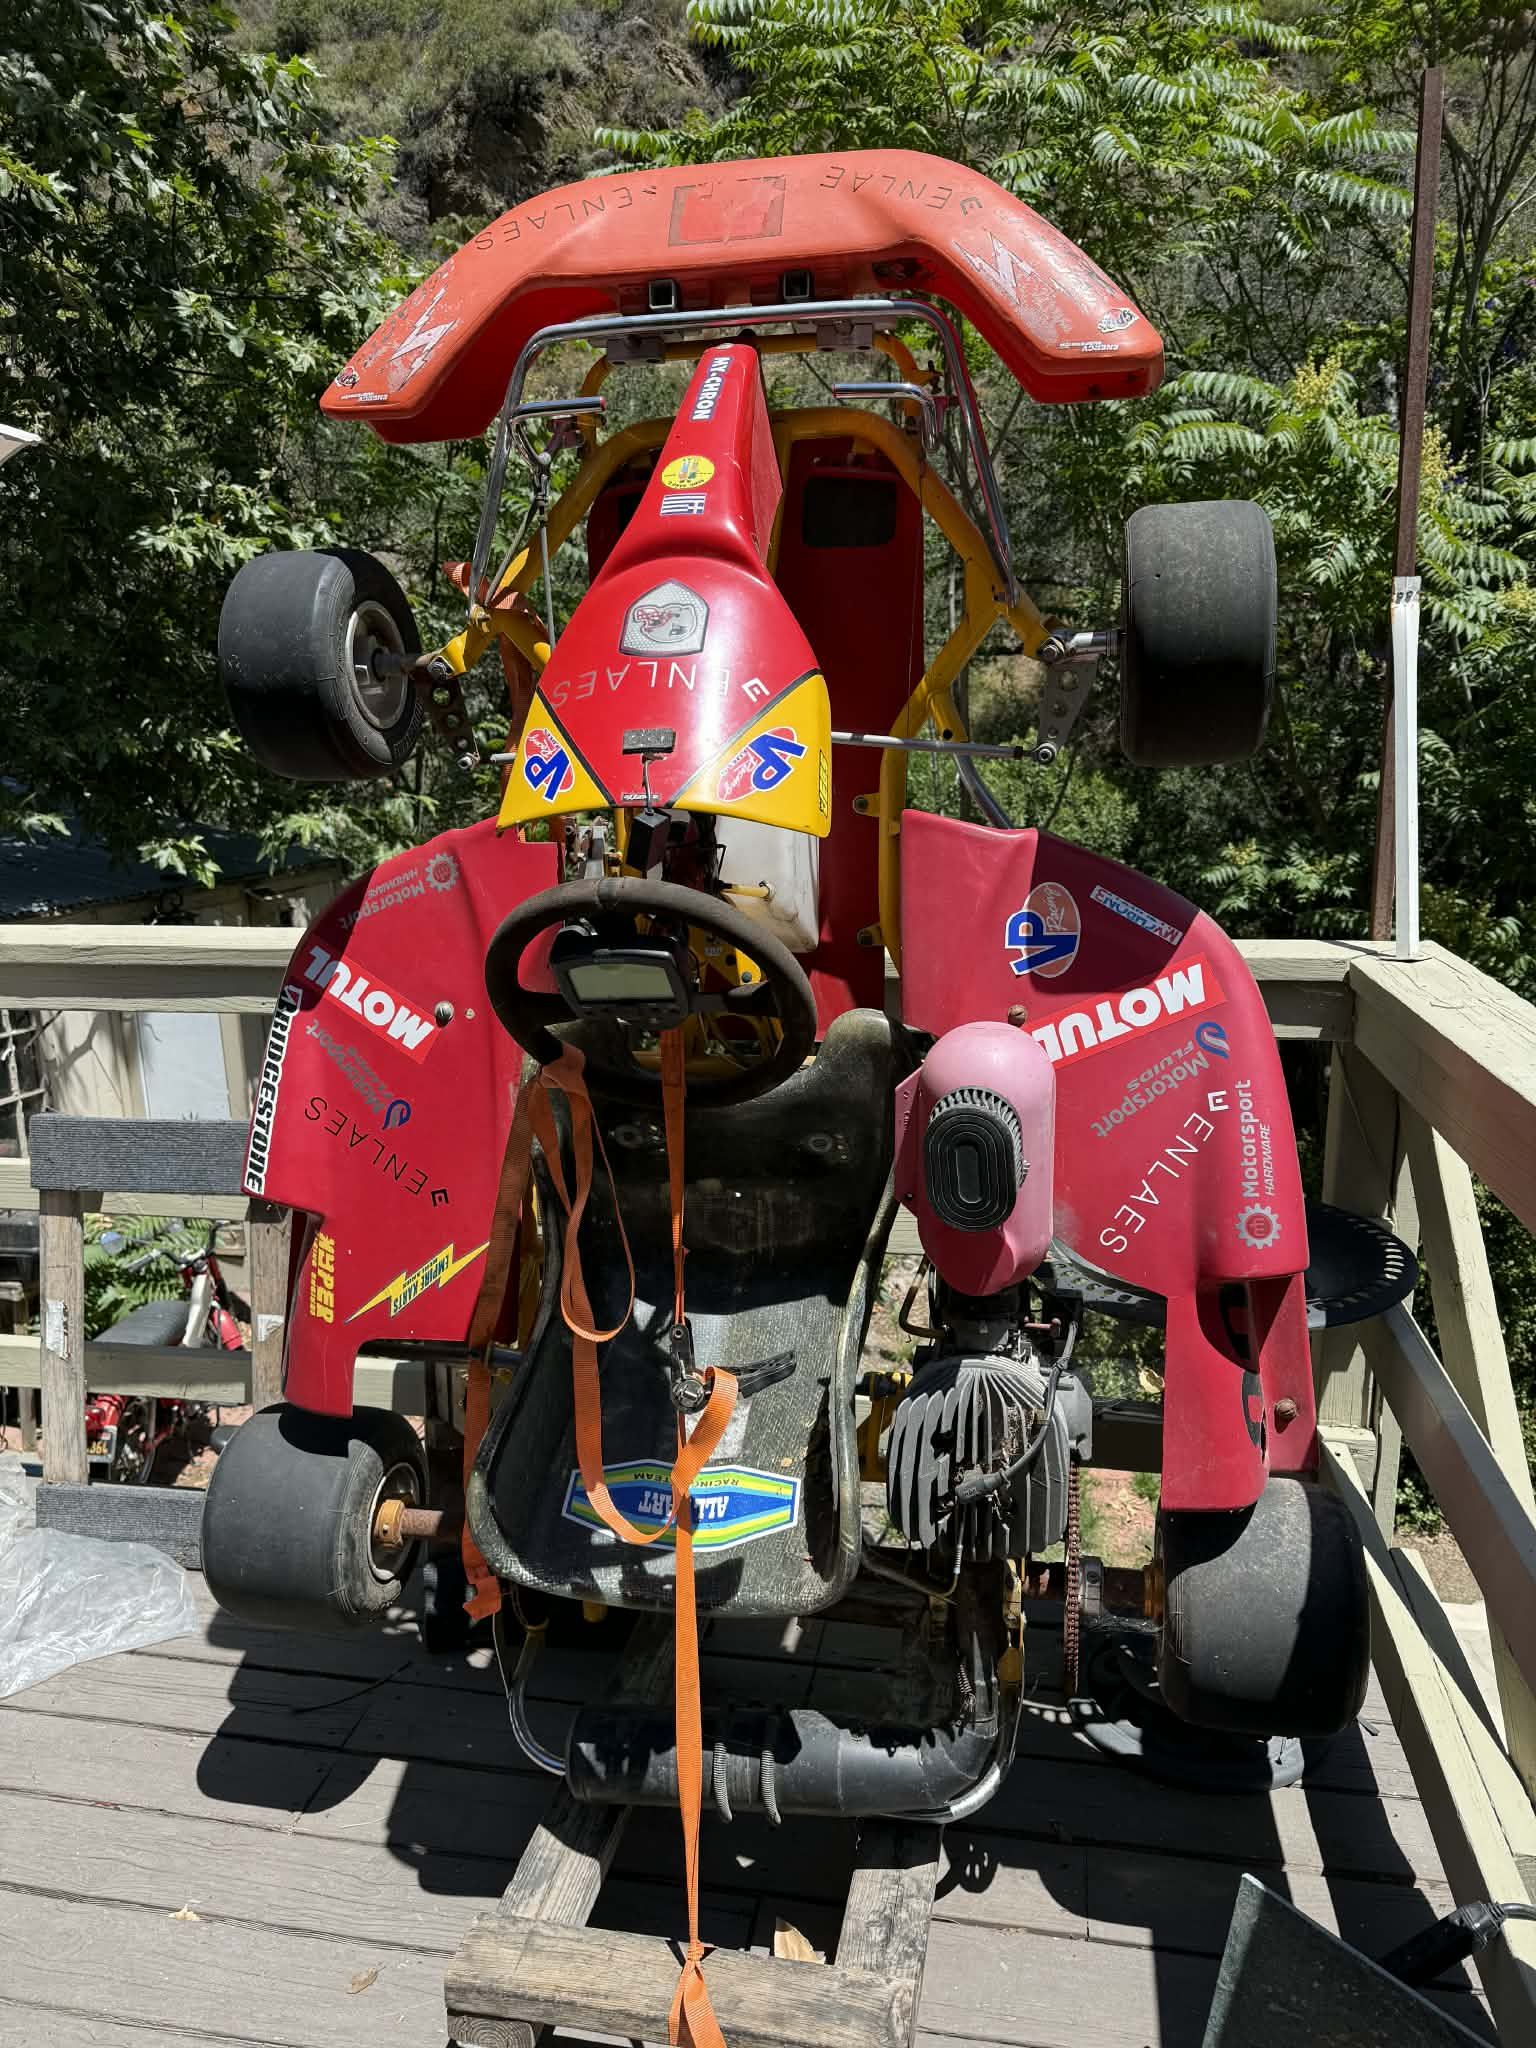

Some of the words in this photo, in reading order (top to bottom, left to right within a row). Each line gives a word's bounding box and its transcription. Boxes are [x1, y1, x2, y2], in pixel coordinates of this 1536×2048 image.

[475, 185, 633, 251] ENLAES
[524, 748, 570, 802] VP
[748, 733, 807, 791] VP
[338, 880, 425, 930] Motorsport
[1005, 909, 1079, 975] VP
[1047, 884, 1065, 932] Racing
[303, 945, 435, 1050] MOTUL
[1032, 964, 1206, 1062] MOTUL
[245, 994, 299, 1193] BRIDGESTONE
[1091, 1052, 1211, 1138] Motorsport
[1127, 1041, 1195, 1091] FLUIDS
[304, 1096, 429, 1196] ENLAES
[1237, 1079, 1259, 1198] Motorsport
[1260, 1123, 1274, 1197] HARDWARE
[1099, 1112, 1216, 1255] ENLAES
[316, 1231, 335, 1324] HYPER
[393, 1281, 419, 1314] KARTS
[421, 1255, 450, 1290] EMPIRE
[694, 1495, 730, 1518] ALL
